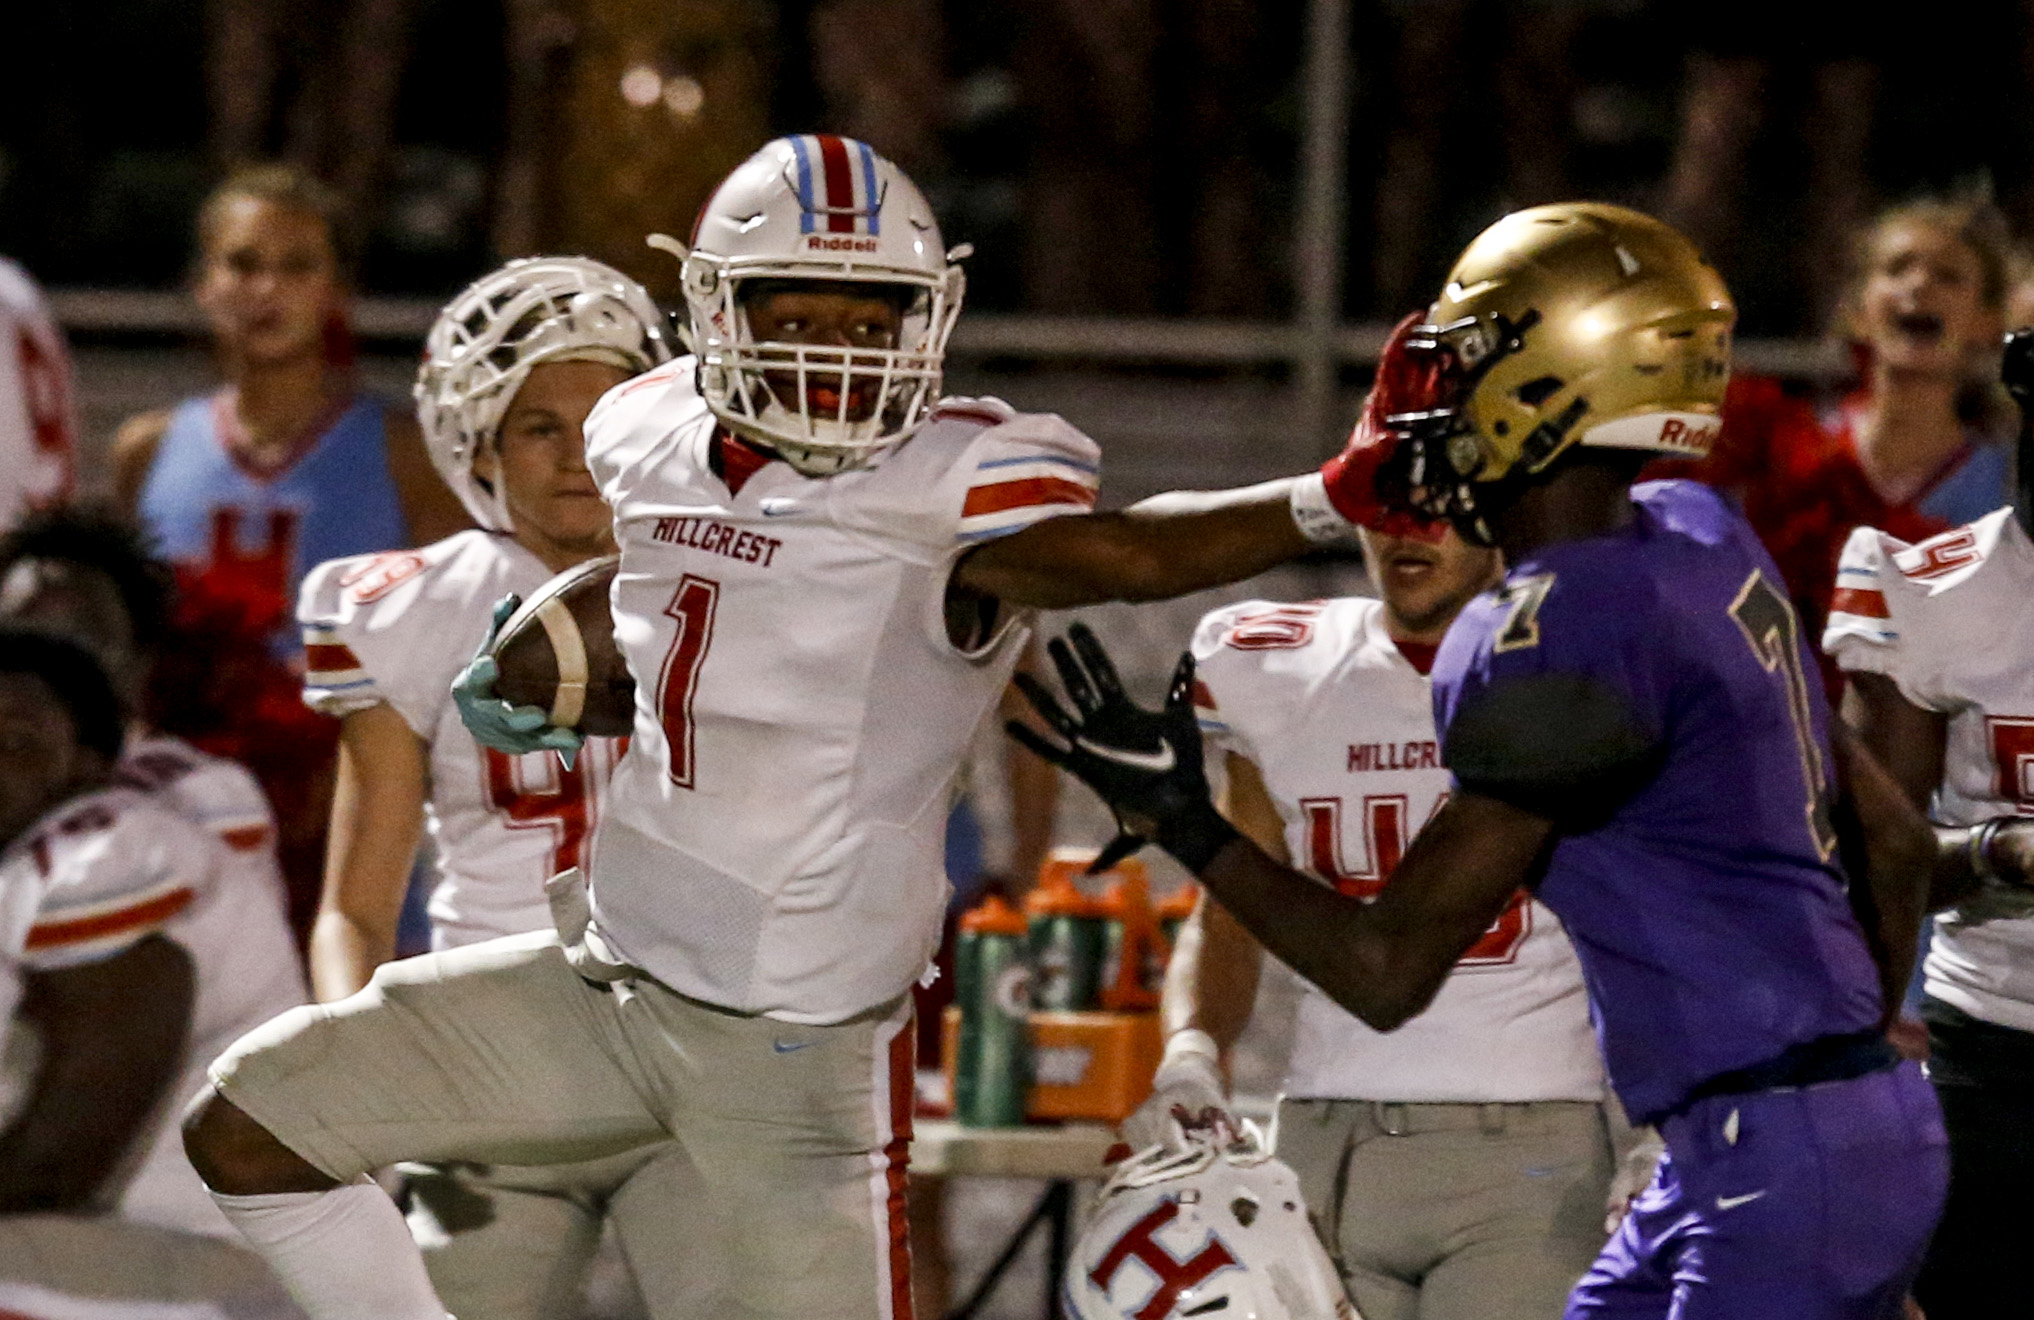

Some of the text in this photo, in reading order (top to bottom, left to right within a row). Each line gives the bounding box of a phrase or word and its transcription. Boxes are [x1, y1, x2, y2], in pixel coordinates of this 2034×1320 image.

[808, 236, 876, 252] Riddell
[653, 516, 782, 568] HILLCREST
[1491, 573, 1557, 653] 7
[655, 573, 720, 790] 1
[1346, 741, 1449, 772] HILLCR
[477, 735, 630, 890] 4
